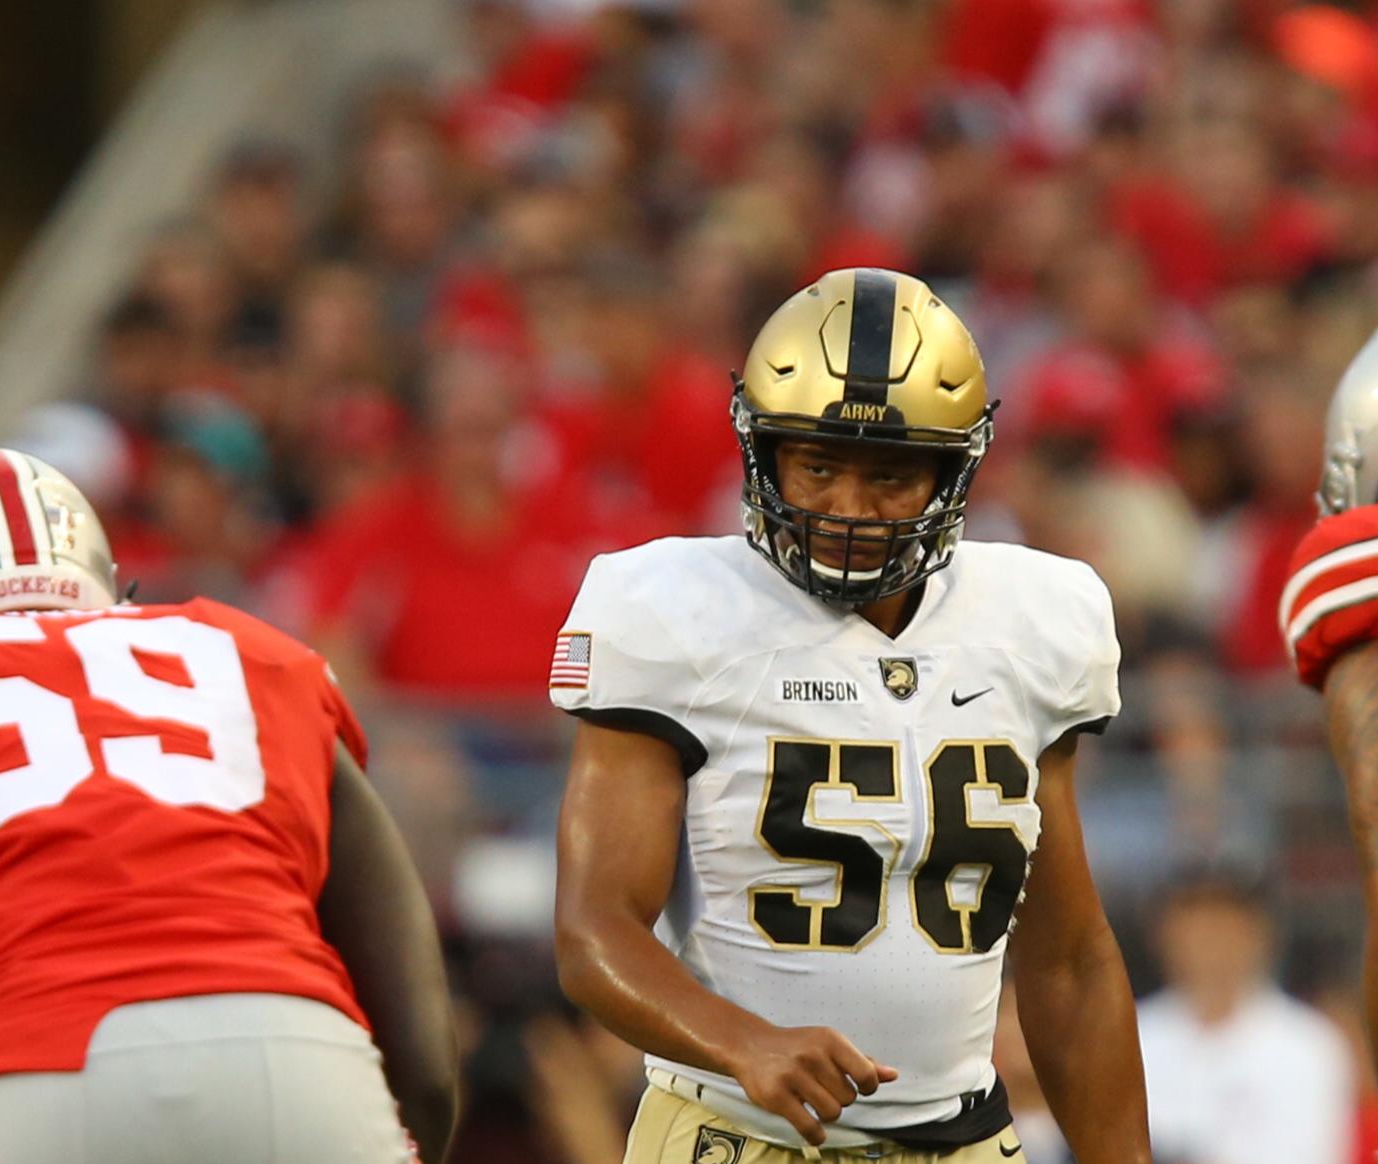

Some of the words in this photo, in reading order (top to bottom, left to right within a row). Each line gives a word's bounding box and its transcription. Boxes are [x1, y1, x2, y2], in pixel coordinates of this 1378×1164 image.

[840, 403, 888, 422] ARMY
[782, 680, 858, 701] BRINSON
[746, 736, 1042, 956] 56
